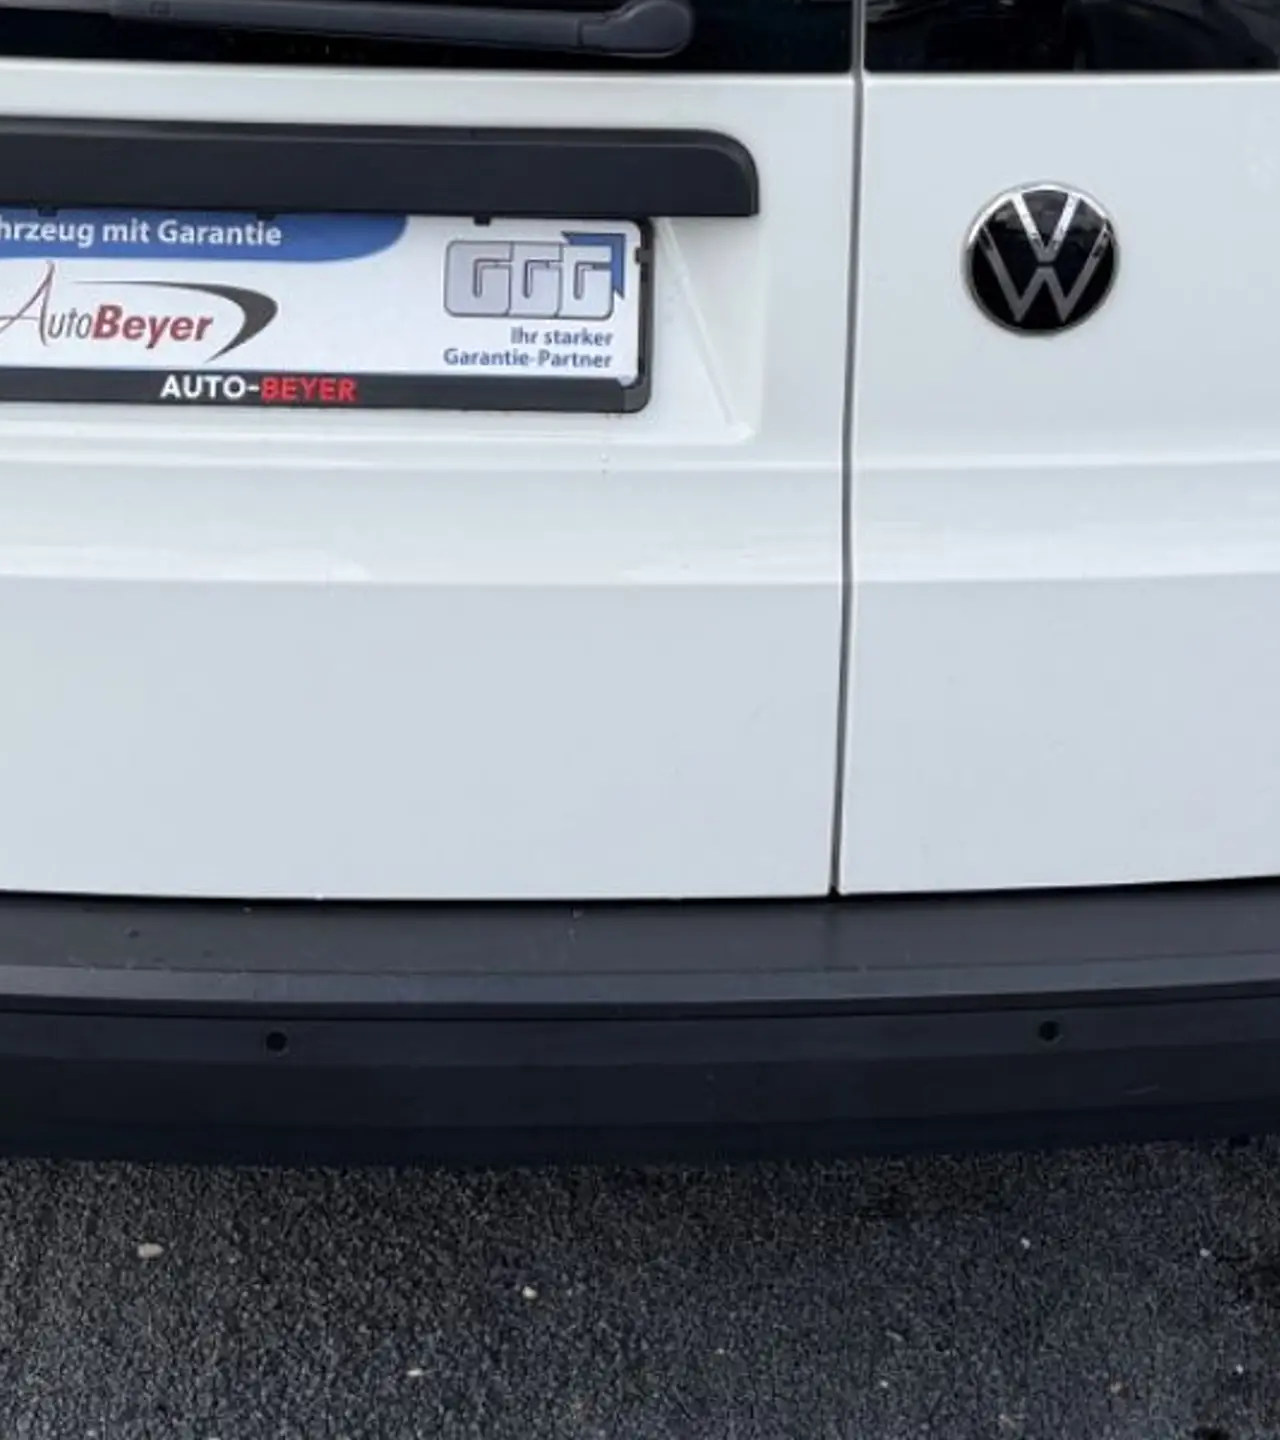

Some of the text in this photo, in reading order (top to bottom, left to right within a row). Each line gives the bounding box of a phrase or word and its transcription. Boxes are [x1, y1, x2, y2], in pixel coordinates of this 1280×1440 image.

[102, 219, 151, 244] mit
[157, 219, 283, 246] Garantie
[510, 326, 614, 347] Ihr starker
[443, 347, 614, 369] Garantie-Partner
[159, 374, 358, 402] AUTO-BEYER
